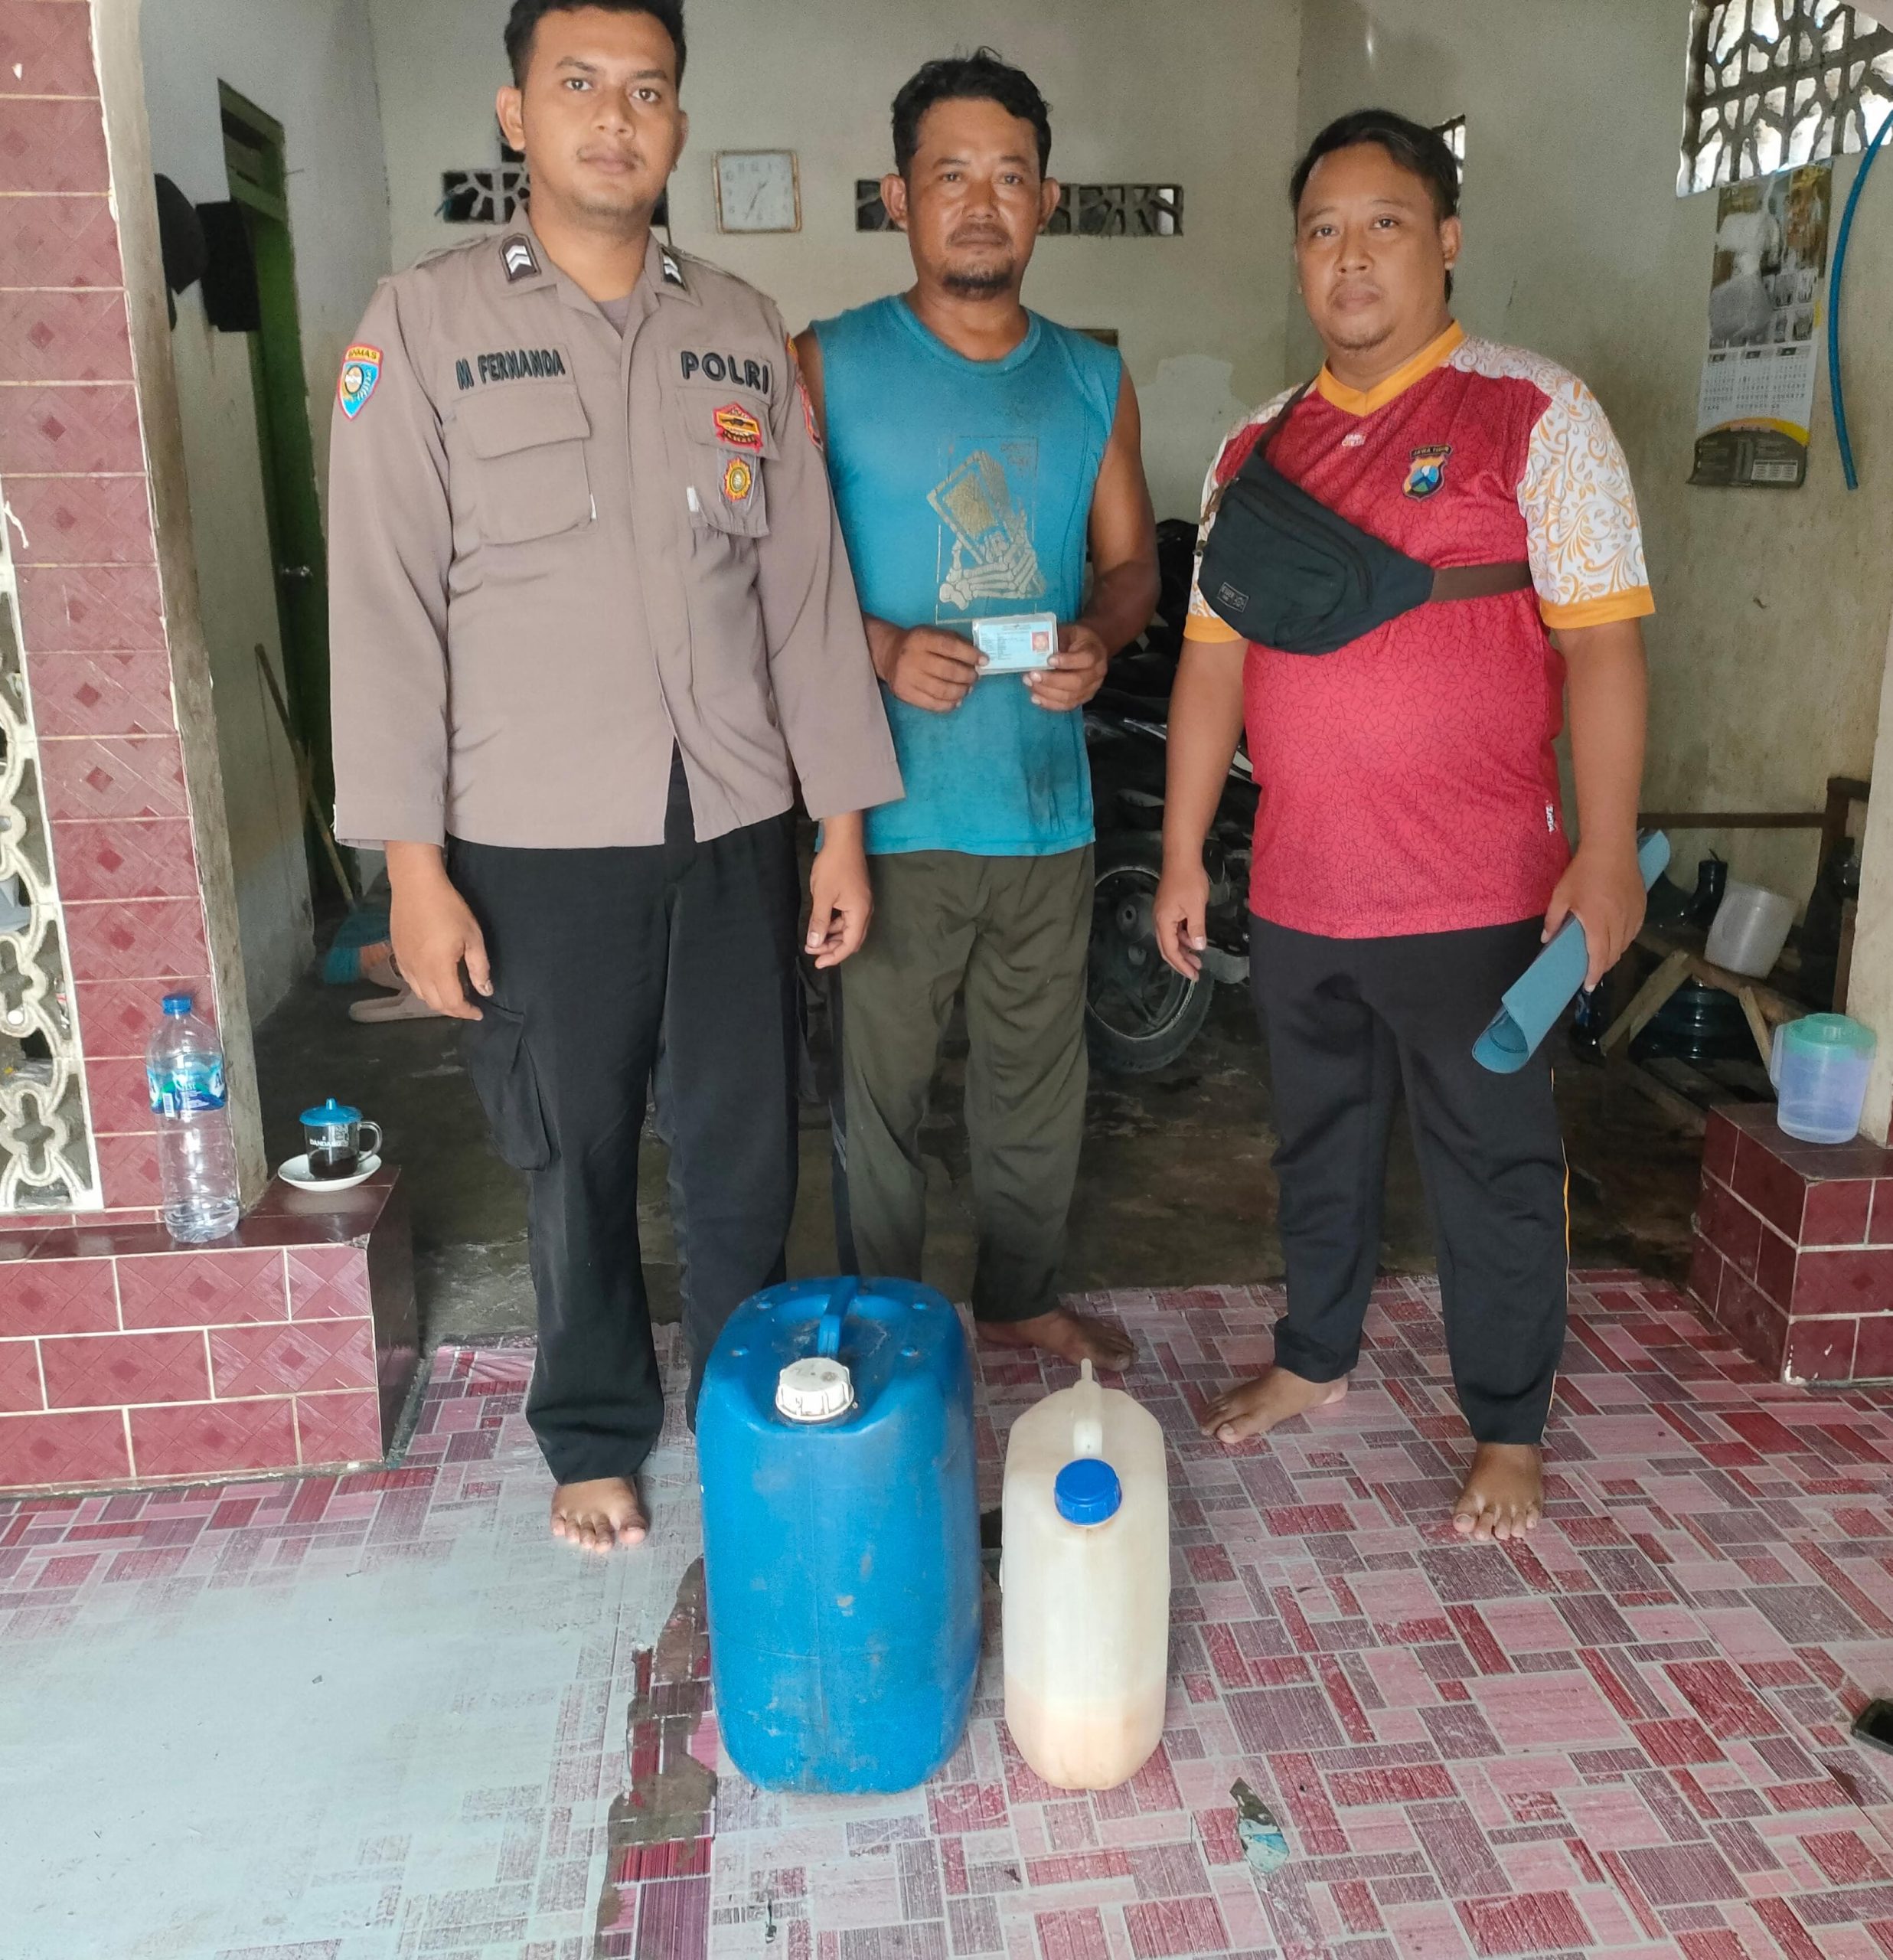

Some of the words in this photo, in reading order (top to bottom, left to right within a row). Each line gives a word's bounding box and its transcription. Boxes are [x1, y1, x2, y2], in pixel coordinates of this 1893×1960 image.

[455, 358, 475, 390] M
[478, 348, 566, 384] FERNANDA
[681, 351, 769, 394] POLRI
